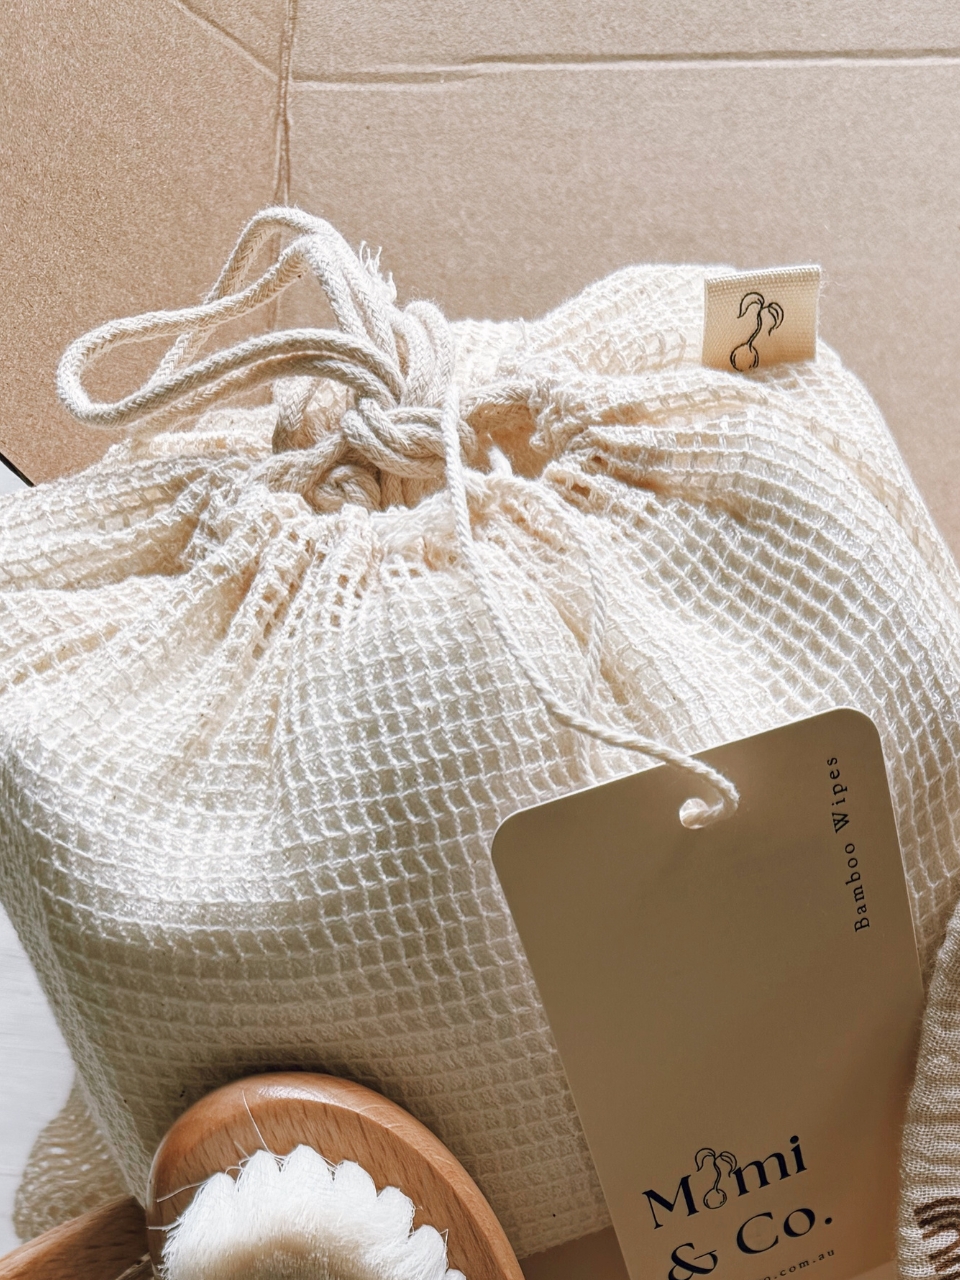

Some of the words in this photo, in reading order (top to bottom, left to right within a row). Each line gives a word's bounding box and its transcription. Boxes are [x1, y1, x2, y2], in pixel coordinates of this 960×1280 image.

[827, 757, 850, 833] Wipes
[845, 842, 870, 932] Bamboo
[736, 1207, 833, 1255] Co.
